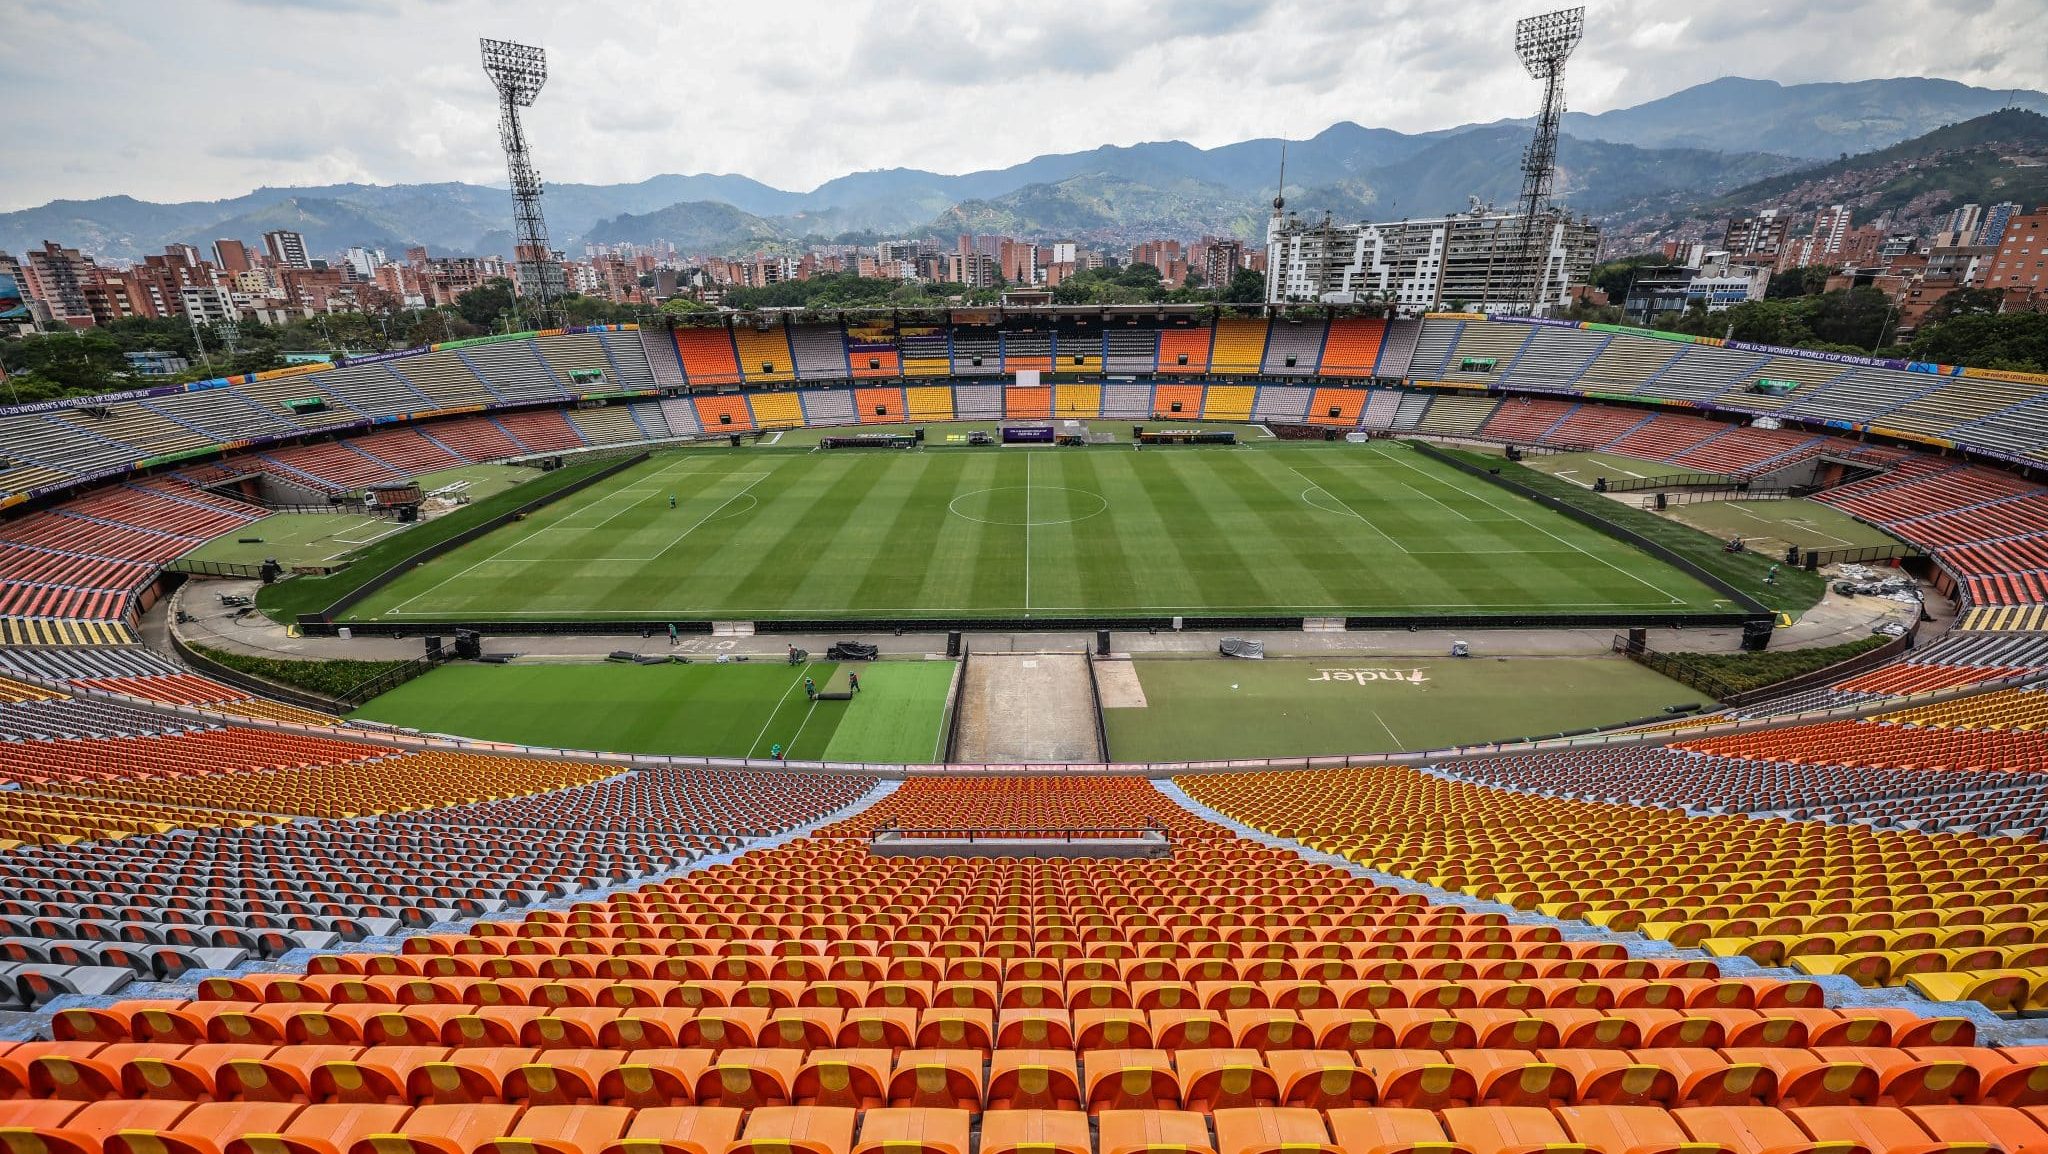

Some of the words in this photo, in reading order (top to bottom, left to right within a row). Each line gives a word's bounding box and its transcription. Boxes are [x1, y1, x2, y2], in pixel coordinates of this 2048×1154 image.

[1735, 342, 1751, 350] FIFA
[1752, 344, 1767, 352] U-20
[1767, 346, 1799, 356] WOMEN'S
[1800, 350, 1824, 359] WORLD
[1826, 353, 1840, 361] CUP
[0, 405, 19, 415] U-20
[19, 402, 58, 414] WOMEN'S
[58, 397, 87, 409] WORLD
